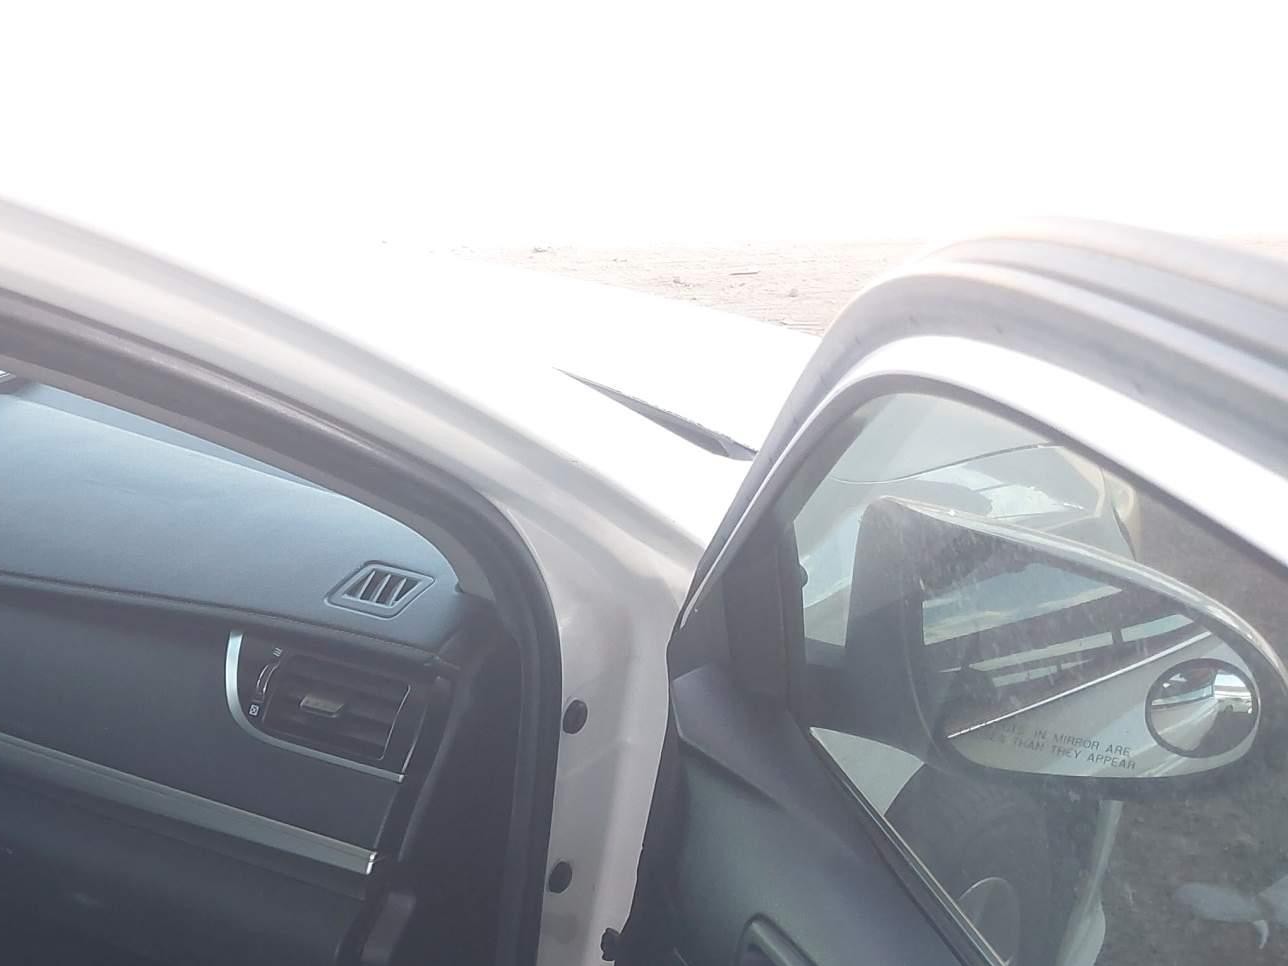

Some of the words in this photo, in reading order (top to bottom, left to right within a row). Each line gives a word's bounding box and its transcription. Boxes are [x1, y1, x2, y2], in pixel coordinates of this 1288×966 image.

[1014, 736, 1045, 752] THAN
[1051, 744, 1082, 759] THEY
[1087, 753, 1136, 770] APPEAR
[1033, 729, 1048, 740] IN
[1053, 733, 1100, 750] MIRROR
[1104, 744, 1131, 757] ARE
